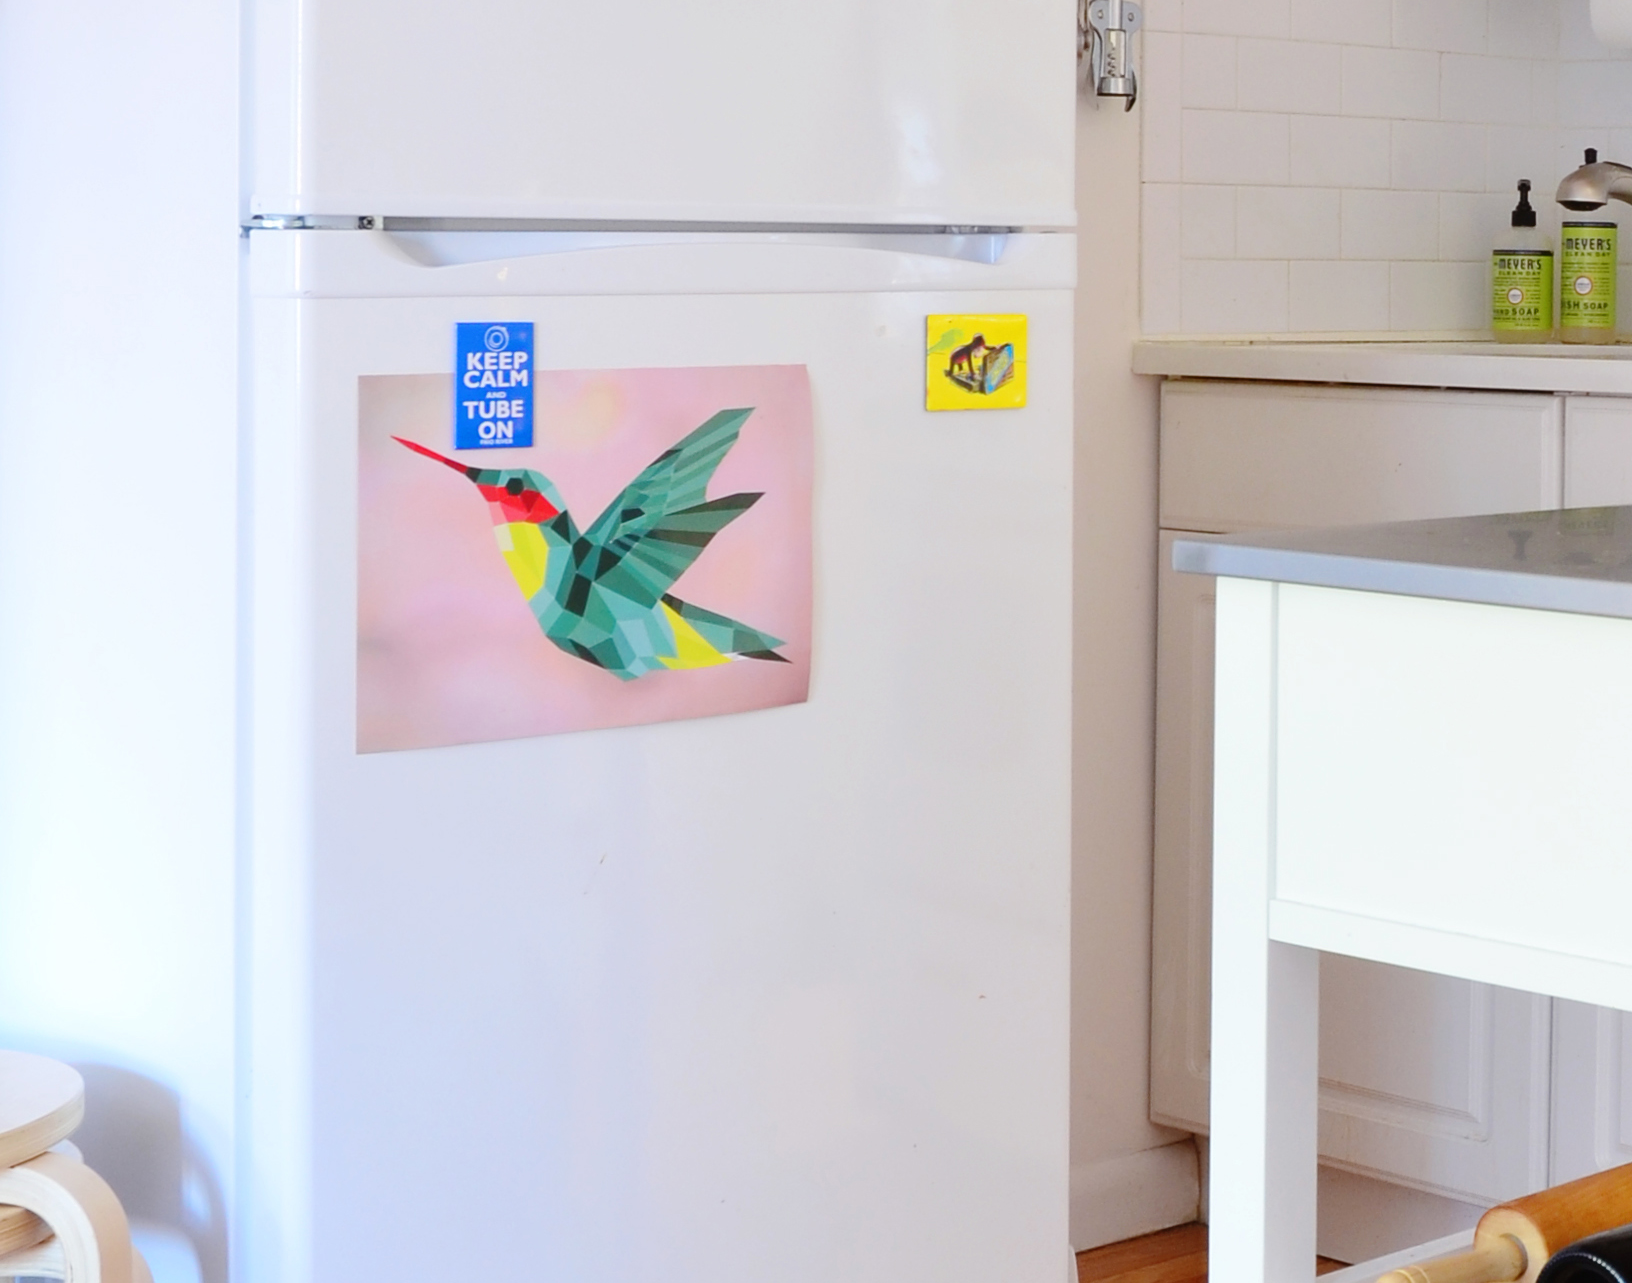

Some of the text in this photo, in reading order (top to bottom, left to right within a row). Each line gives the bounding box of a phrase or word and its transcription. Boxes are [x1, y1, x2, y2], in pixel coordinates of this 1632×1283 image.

[1566, 238, 1611, 250] MEYER'S
[1498, 258, 1542, 270] MEYER'S
[1511, 307, 1539, 316] SOAP
[1583, 302, 1609, 310] SOAP
[466, 351, 528, 370] KEEP
[463, 369, 528, 388] CALM
[486, 391, 507, 399] AND
[462, 399, 524, 419] TUBE
[477, 420, 514, 439] ON
